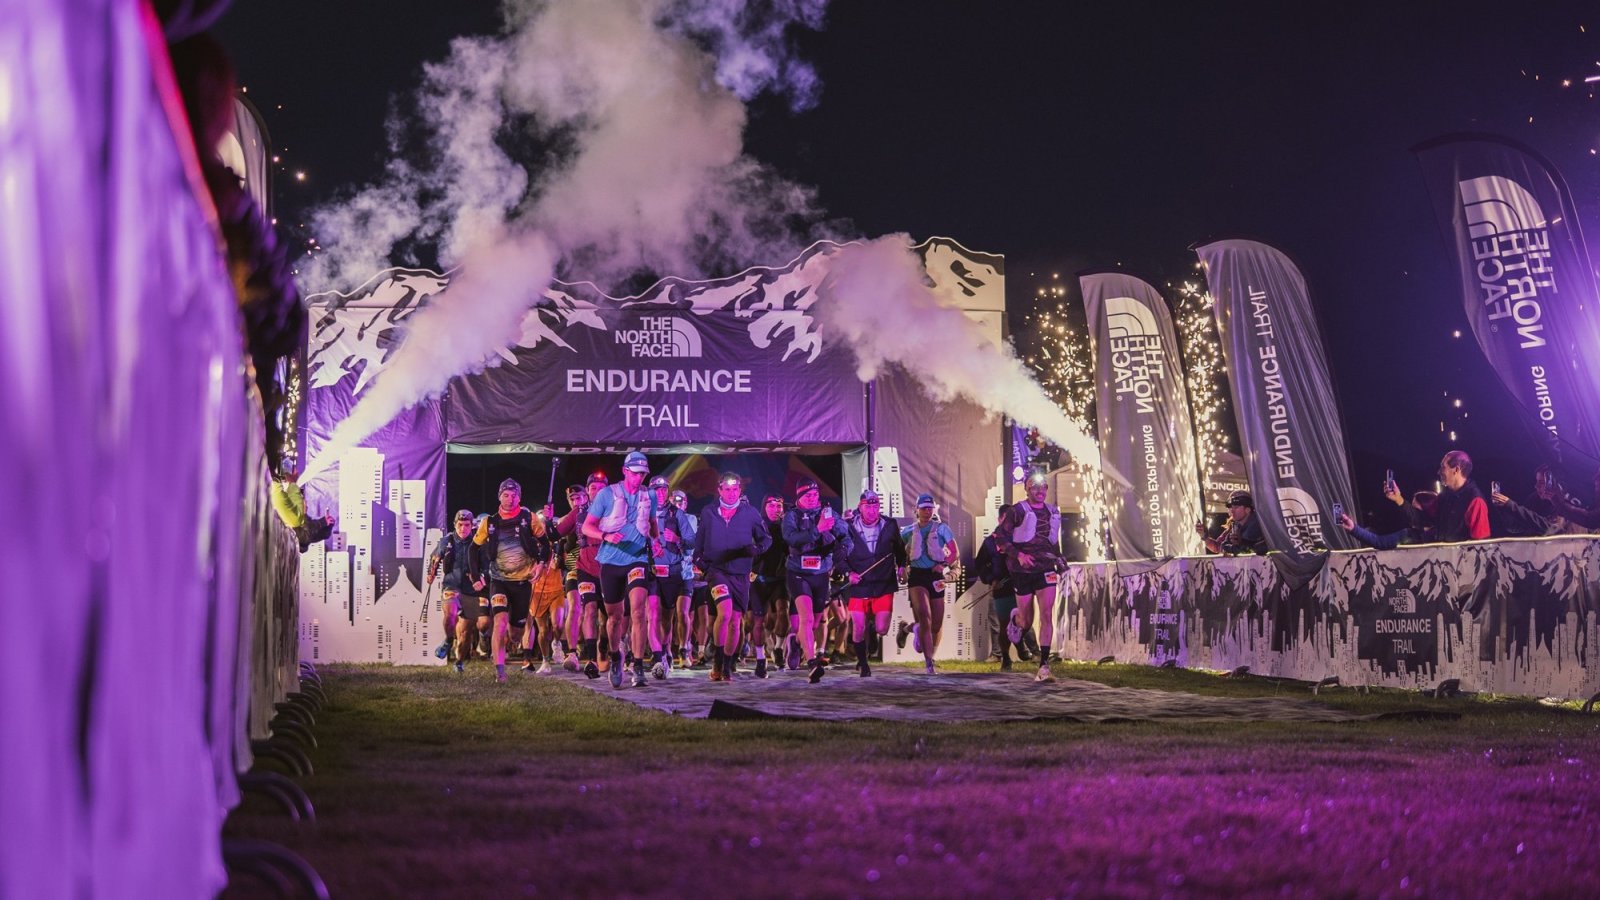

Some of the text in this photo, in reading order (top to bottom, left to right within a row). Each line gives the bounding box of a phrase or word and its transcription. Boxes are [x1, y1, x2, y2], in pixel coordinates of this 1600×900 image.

[640, 316, 672, 330] THE
[615, 330, 672, 344] NORTH
[631, 343, 672, 358] FACE
[566, 369, 752, 393] ENDURANCE
[618, 404, 699, 428] TRAIL
[1375, 618, 1432, 634] ENDURANCE
[1392, 638, 1417, 654] TRAIL
